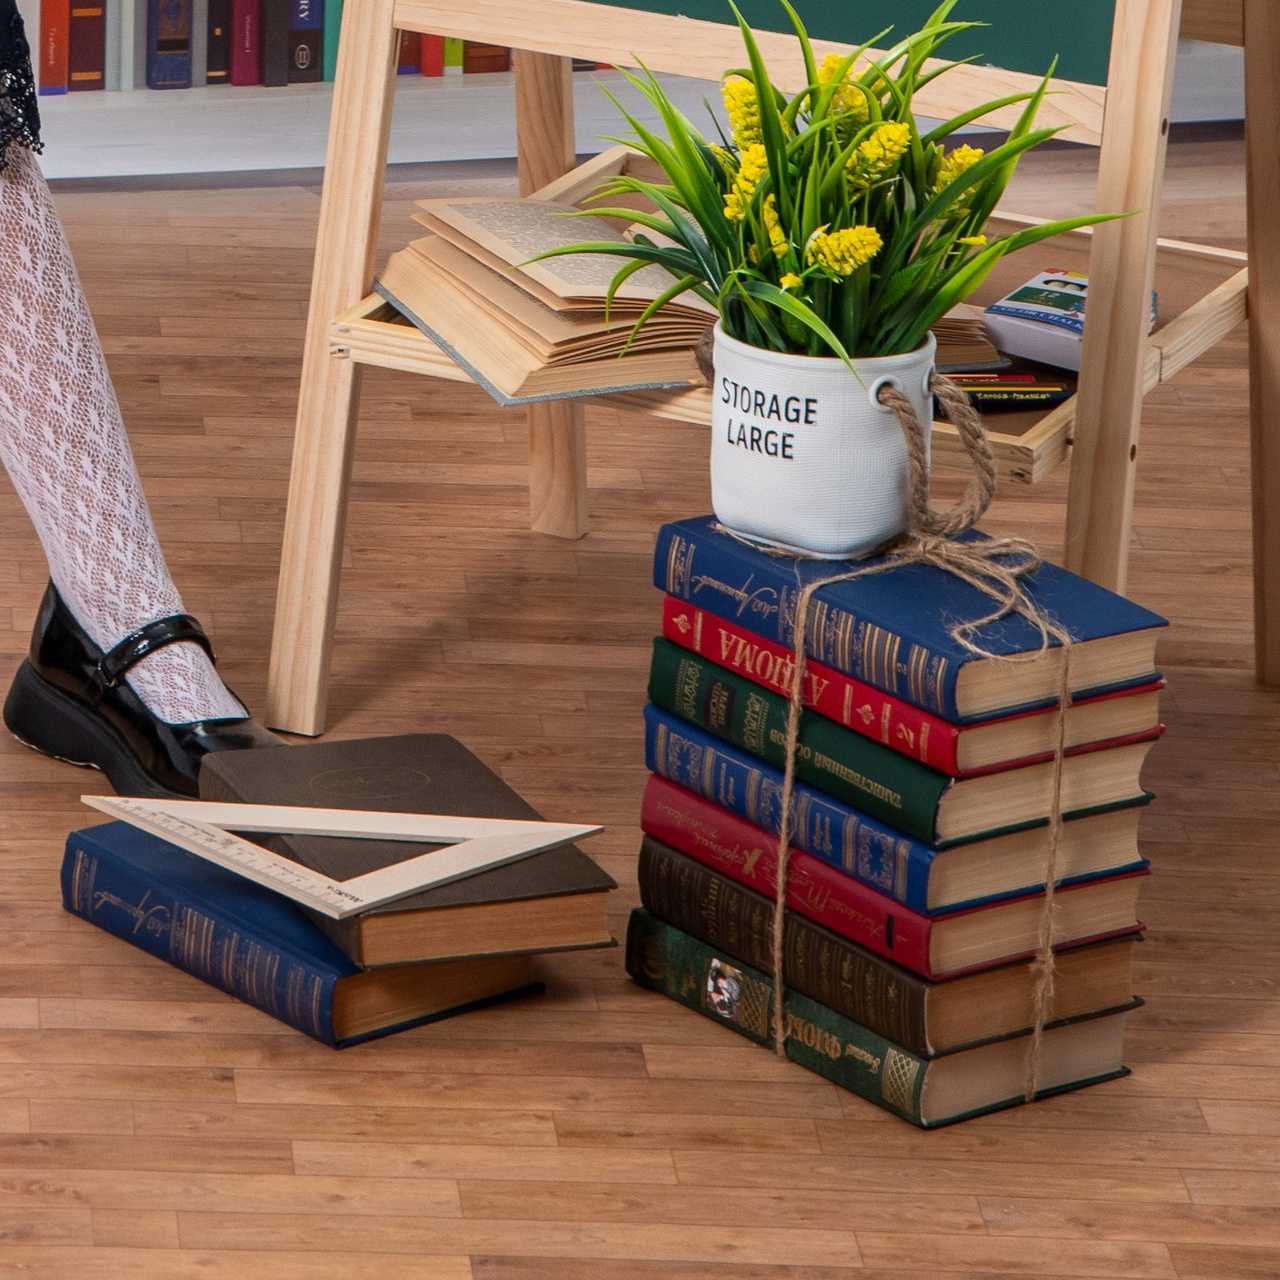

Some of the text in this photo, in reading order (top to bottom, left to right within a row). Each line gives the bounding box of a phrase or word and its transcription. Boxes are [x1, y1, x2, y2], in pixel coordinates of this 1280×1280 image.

[721, 375, 818, 427] STORAGE
[725, 422, 796, 462] LARGE
[769, 727, 904, 809] ТАИНСТВЕННЫЙ ОСОВ
